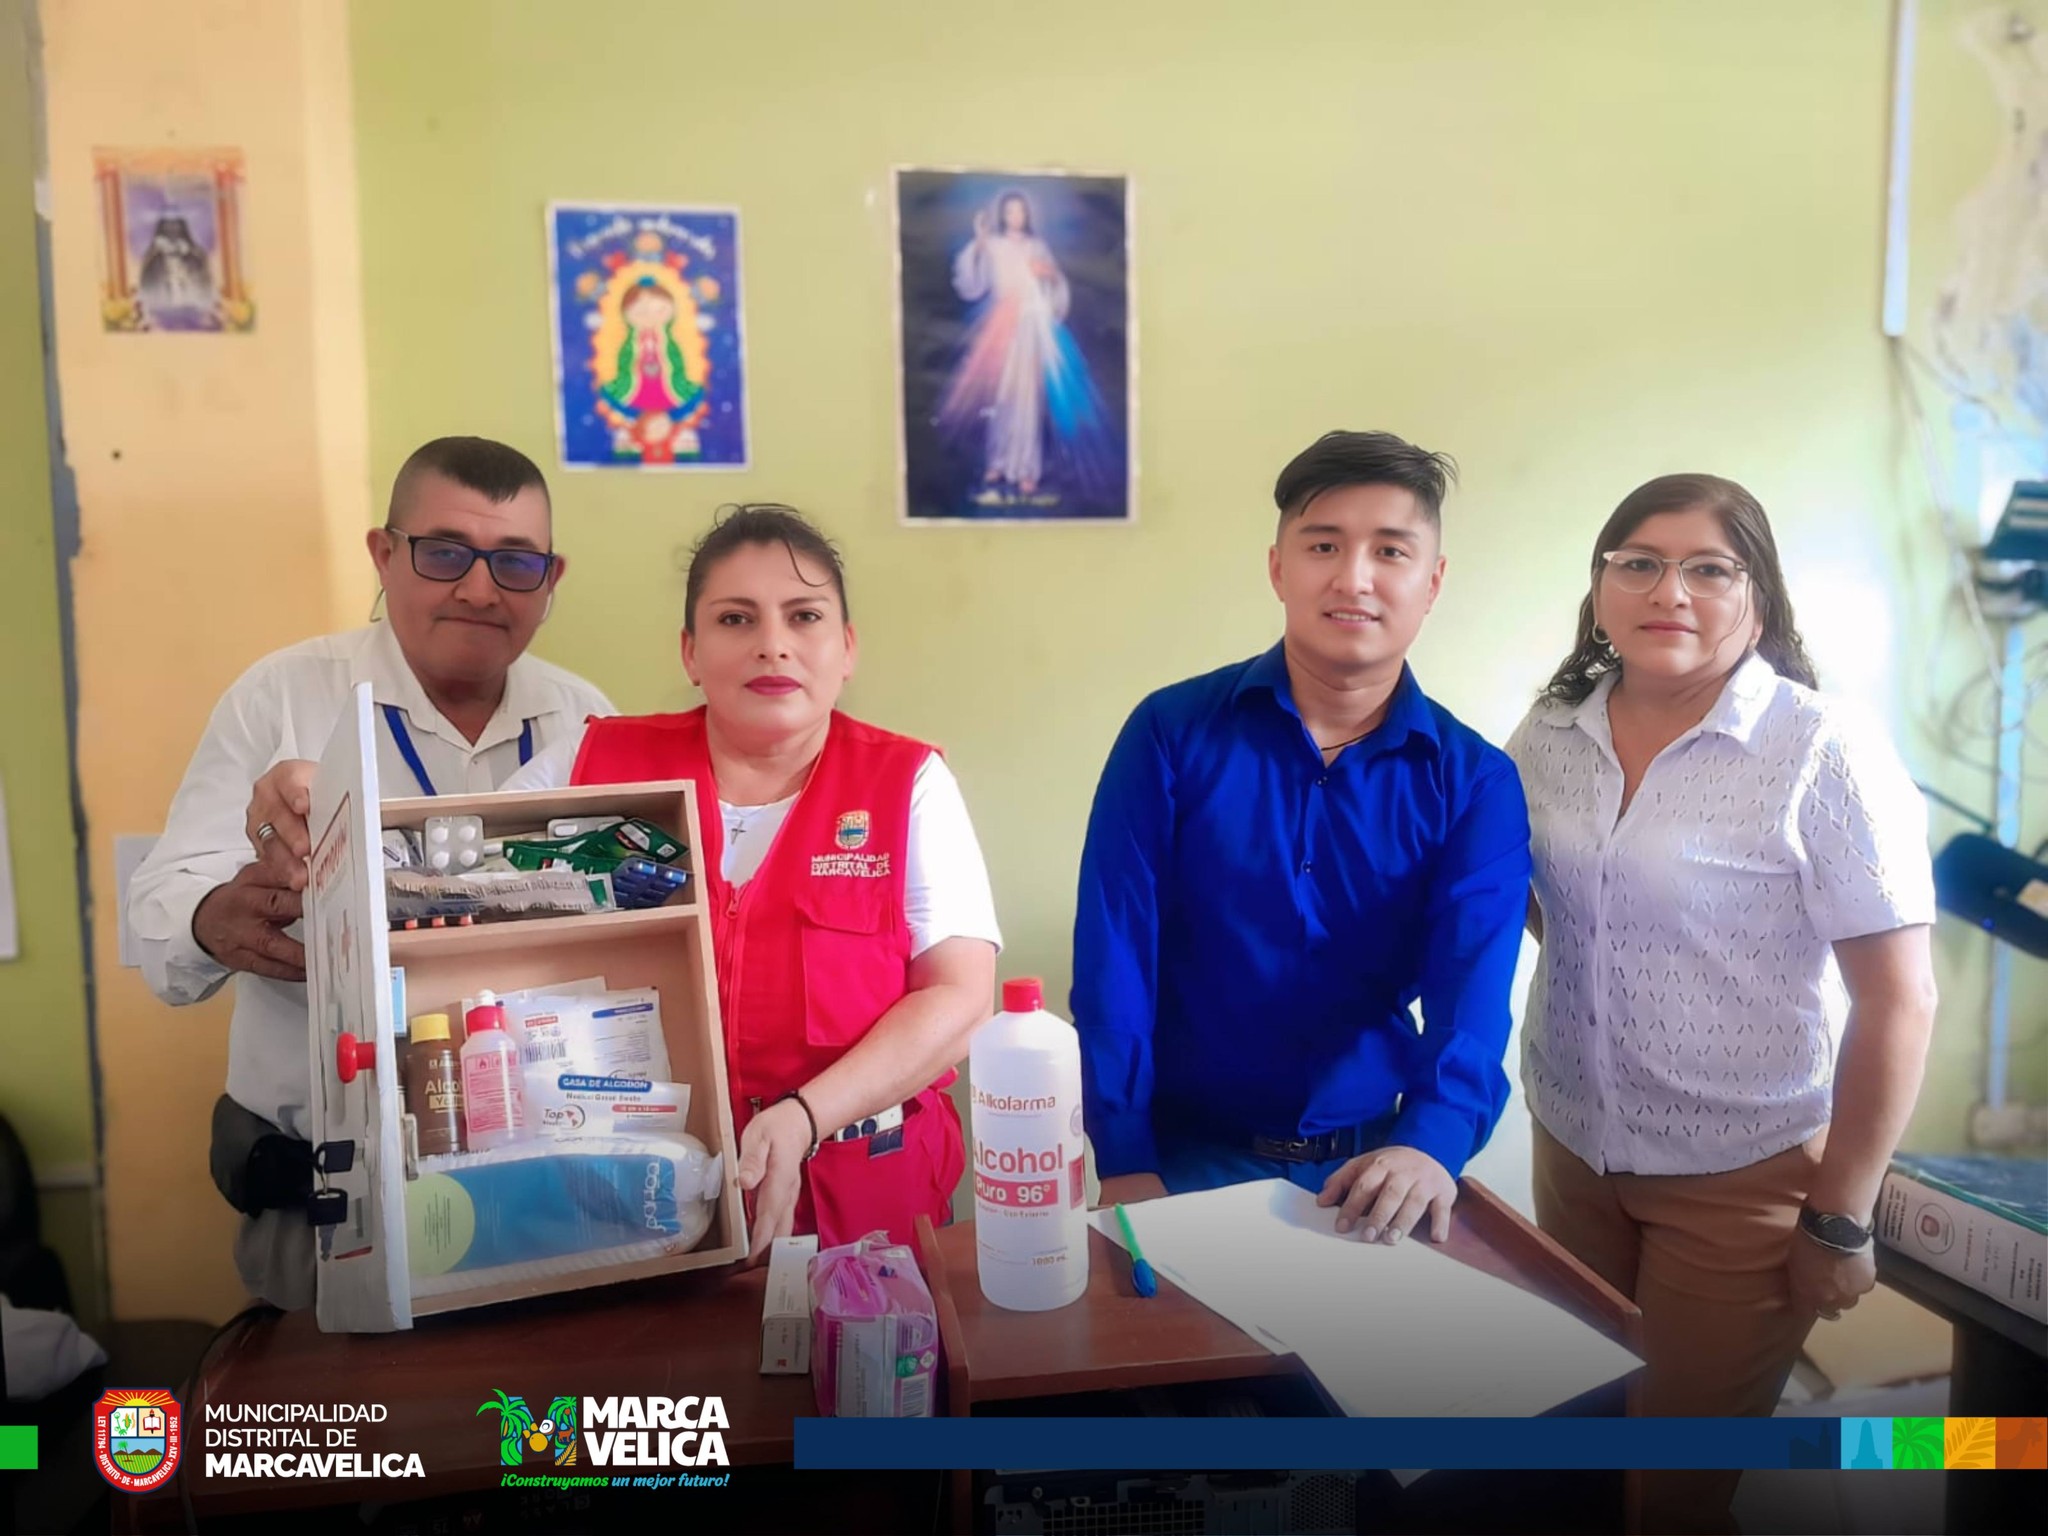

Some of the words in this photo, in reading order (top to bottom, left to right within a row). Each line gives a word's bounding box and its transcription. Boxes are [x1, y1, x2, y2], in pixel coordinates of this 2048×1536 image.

[811, 852, 890, 863] MUNICIPALIDAD
[811, 861, 868, 871] DISTRITAL
[810, 868, 891, 878] MARCAVELICA
[544, 1108, 564, 1121] Top
[974, 1137, 1063, 1174] Alcohol
[976, 1175, 1007, 1202] Puro
[1017, 1184, 1051, 1203] 96°
